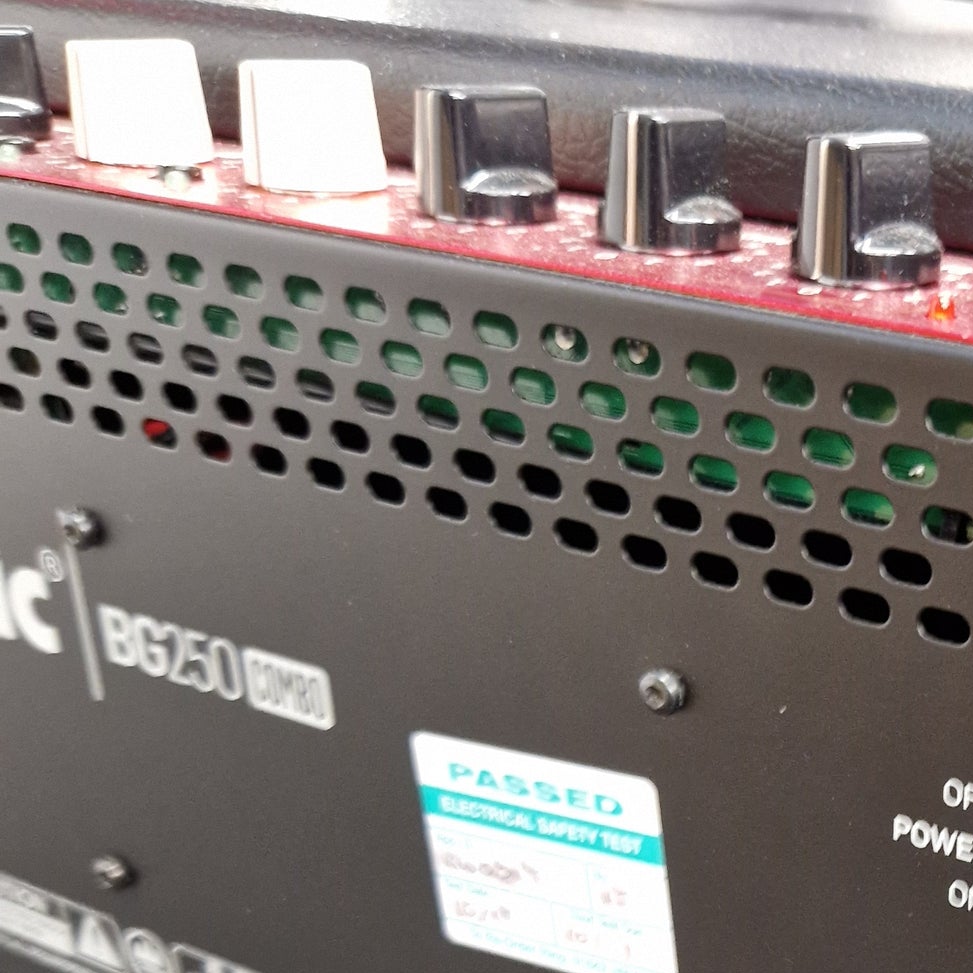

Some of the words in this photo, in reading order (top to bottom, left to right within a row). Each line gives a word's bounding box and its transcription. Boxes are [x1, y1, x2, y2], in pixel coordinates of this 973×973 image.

[97, 603, 244, 700] BG250
[448, 762, 624, 816] PASSED
[438, 796, 536, 832] ELECTRICAL
[536, 817, 600, 846] SAFETY
[599, 831, 645, 856] TEST
